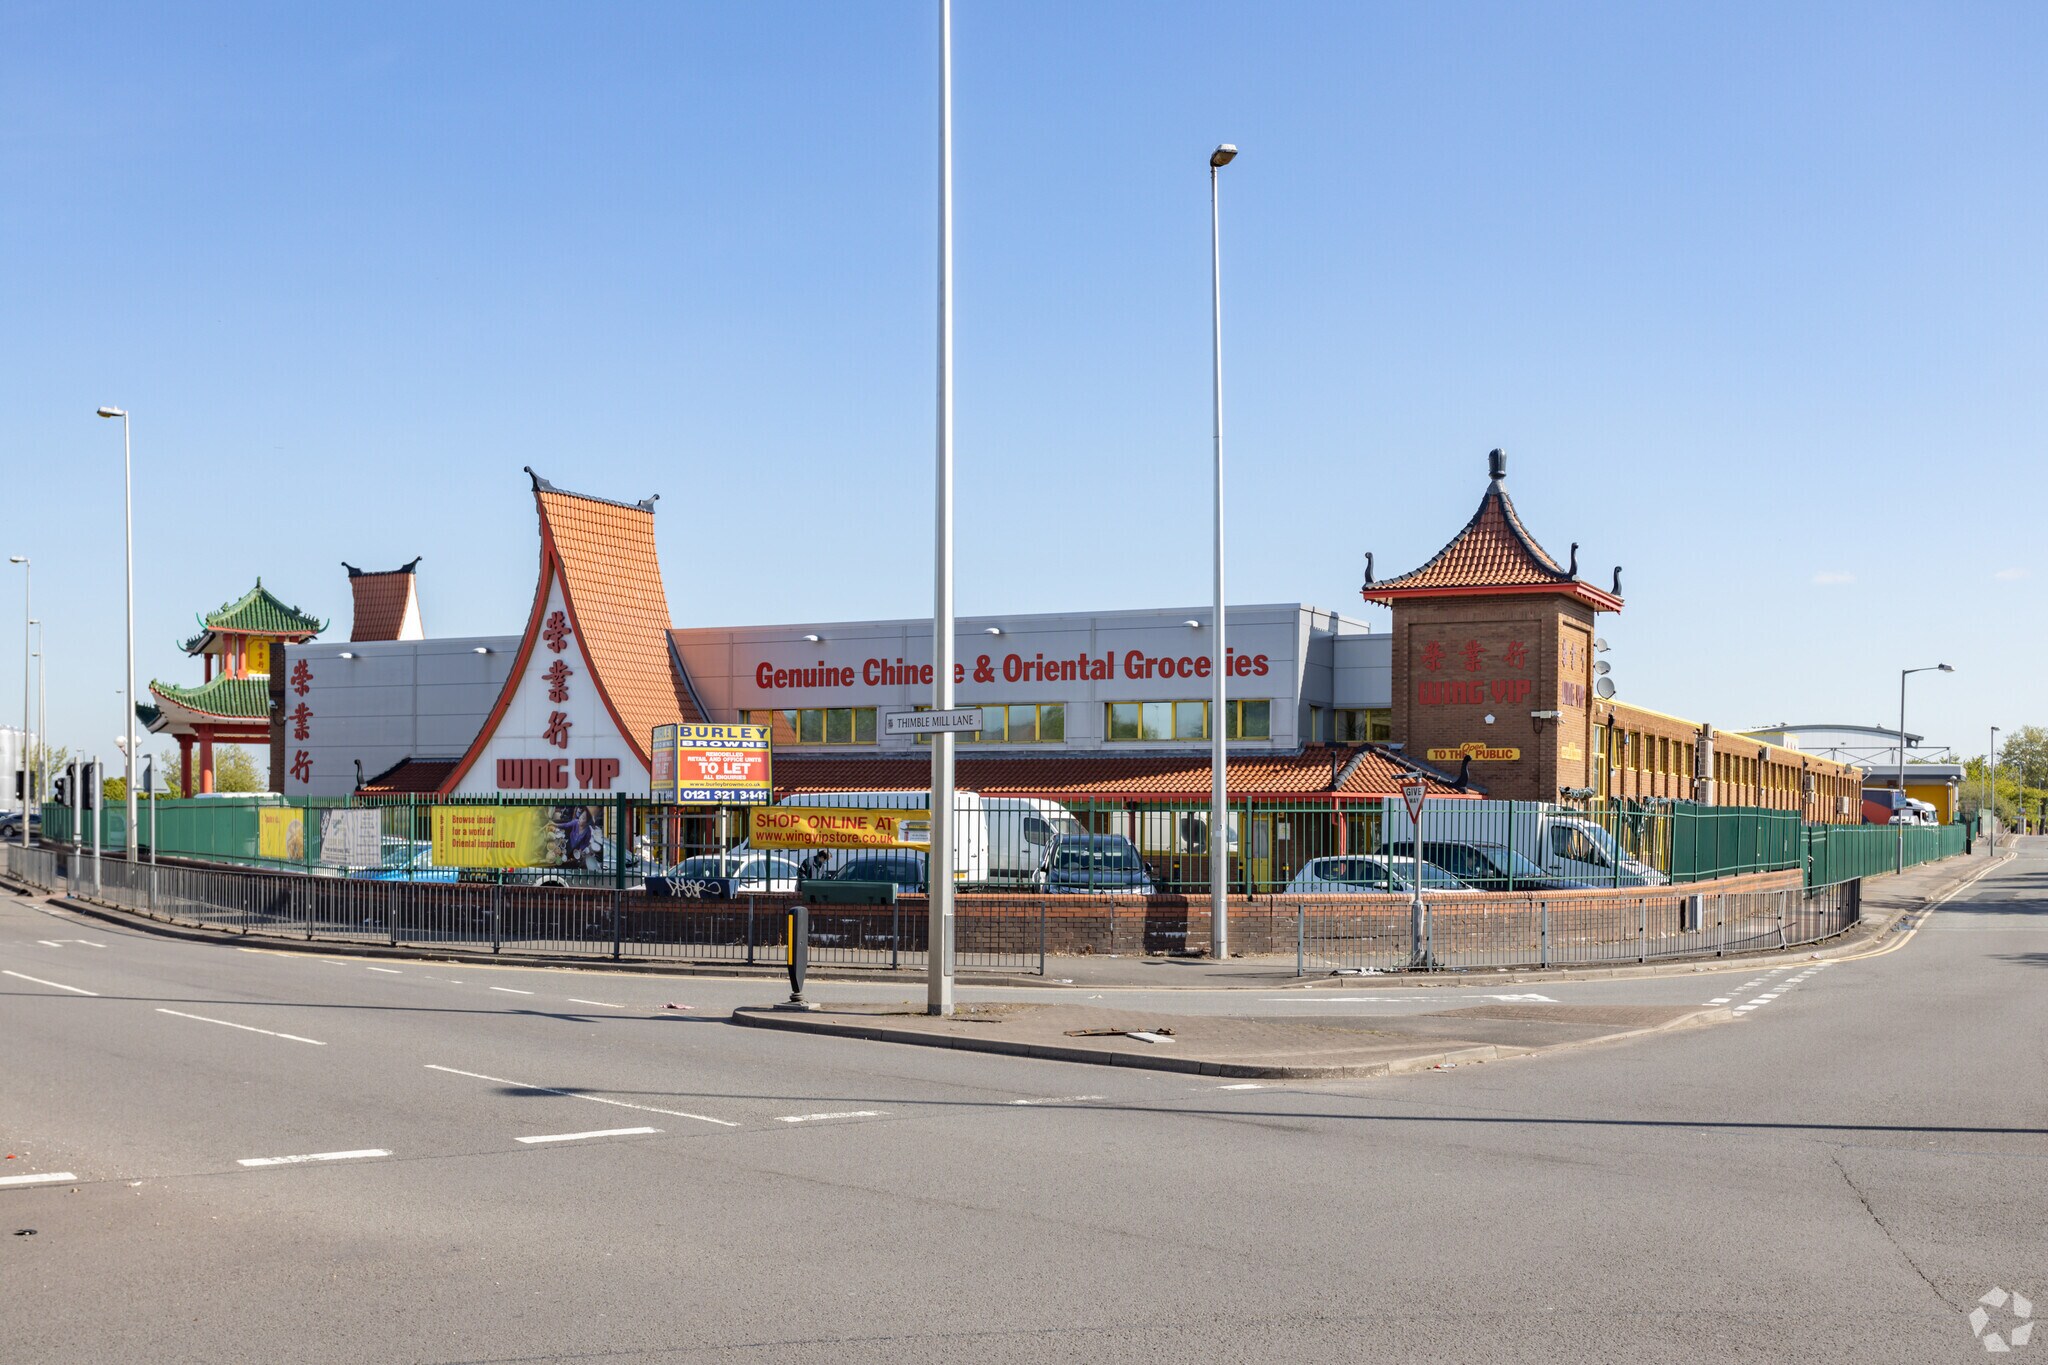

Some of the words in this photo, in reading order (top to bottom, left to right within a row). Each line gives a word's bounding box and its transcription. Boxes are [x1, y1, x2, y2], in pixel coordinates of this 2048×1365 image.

[756, 660, 855, 688] Genuine
[863, 658, 965, 685] Chinee
[973, 654, 995, 683] &
[1003, 651, 1115, 682] Oriental
[1124, 647, 1269, 679] Groceies
[1418, 680, 1484, 705] WING
[1491, 679, 1532, 703] YIP
[897, 717, 930, 728] THIMBLE
[932, 716, 950, 727] MILL
[952, 715, 974, 726] LANE
[680, 726, 768, 739] BURLEY
[682, 740, 767, 748] BROWNE
[1462, 743, 1485, 752] Open
[1433, 750, 1446, 759] TO
[1475, 749, 1513, 759] PUBLIC
[497, 758, 568, 789] WING
[575, 758, 619, 789] YIP
[699, 762, 719, 774] TO
[723, 762, 751, 774] LET
[683, 790, 710, 799] 0121
[714, 790, 735, 799] 321
[740, 790, 767, 800] 3441
[1406, 788, 1421, 796] GIVE
[452, 815, 475, 823] Browse
[477, 815, 496, 823] inside
[756, 814, 800, 828] SHOP
[807, 815, 868, 829] ONLINE
[875, 817, 895, 830] AT
[452, 827, 461, 836] for
[469, 827, 485, 836] world
[487, 827, 494, 836] of
[756, 830, 893, 844] www.wingyipstore.co.uk
[452, 839, 476, 848] Oriental
